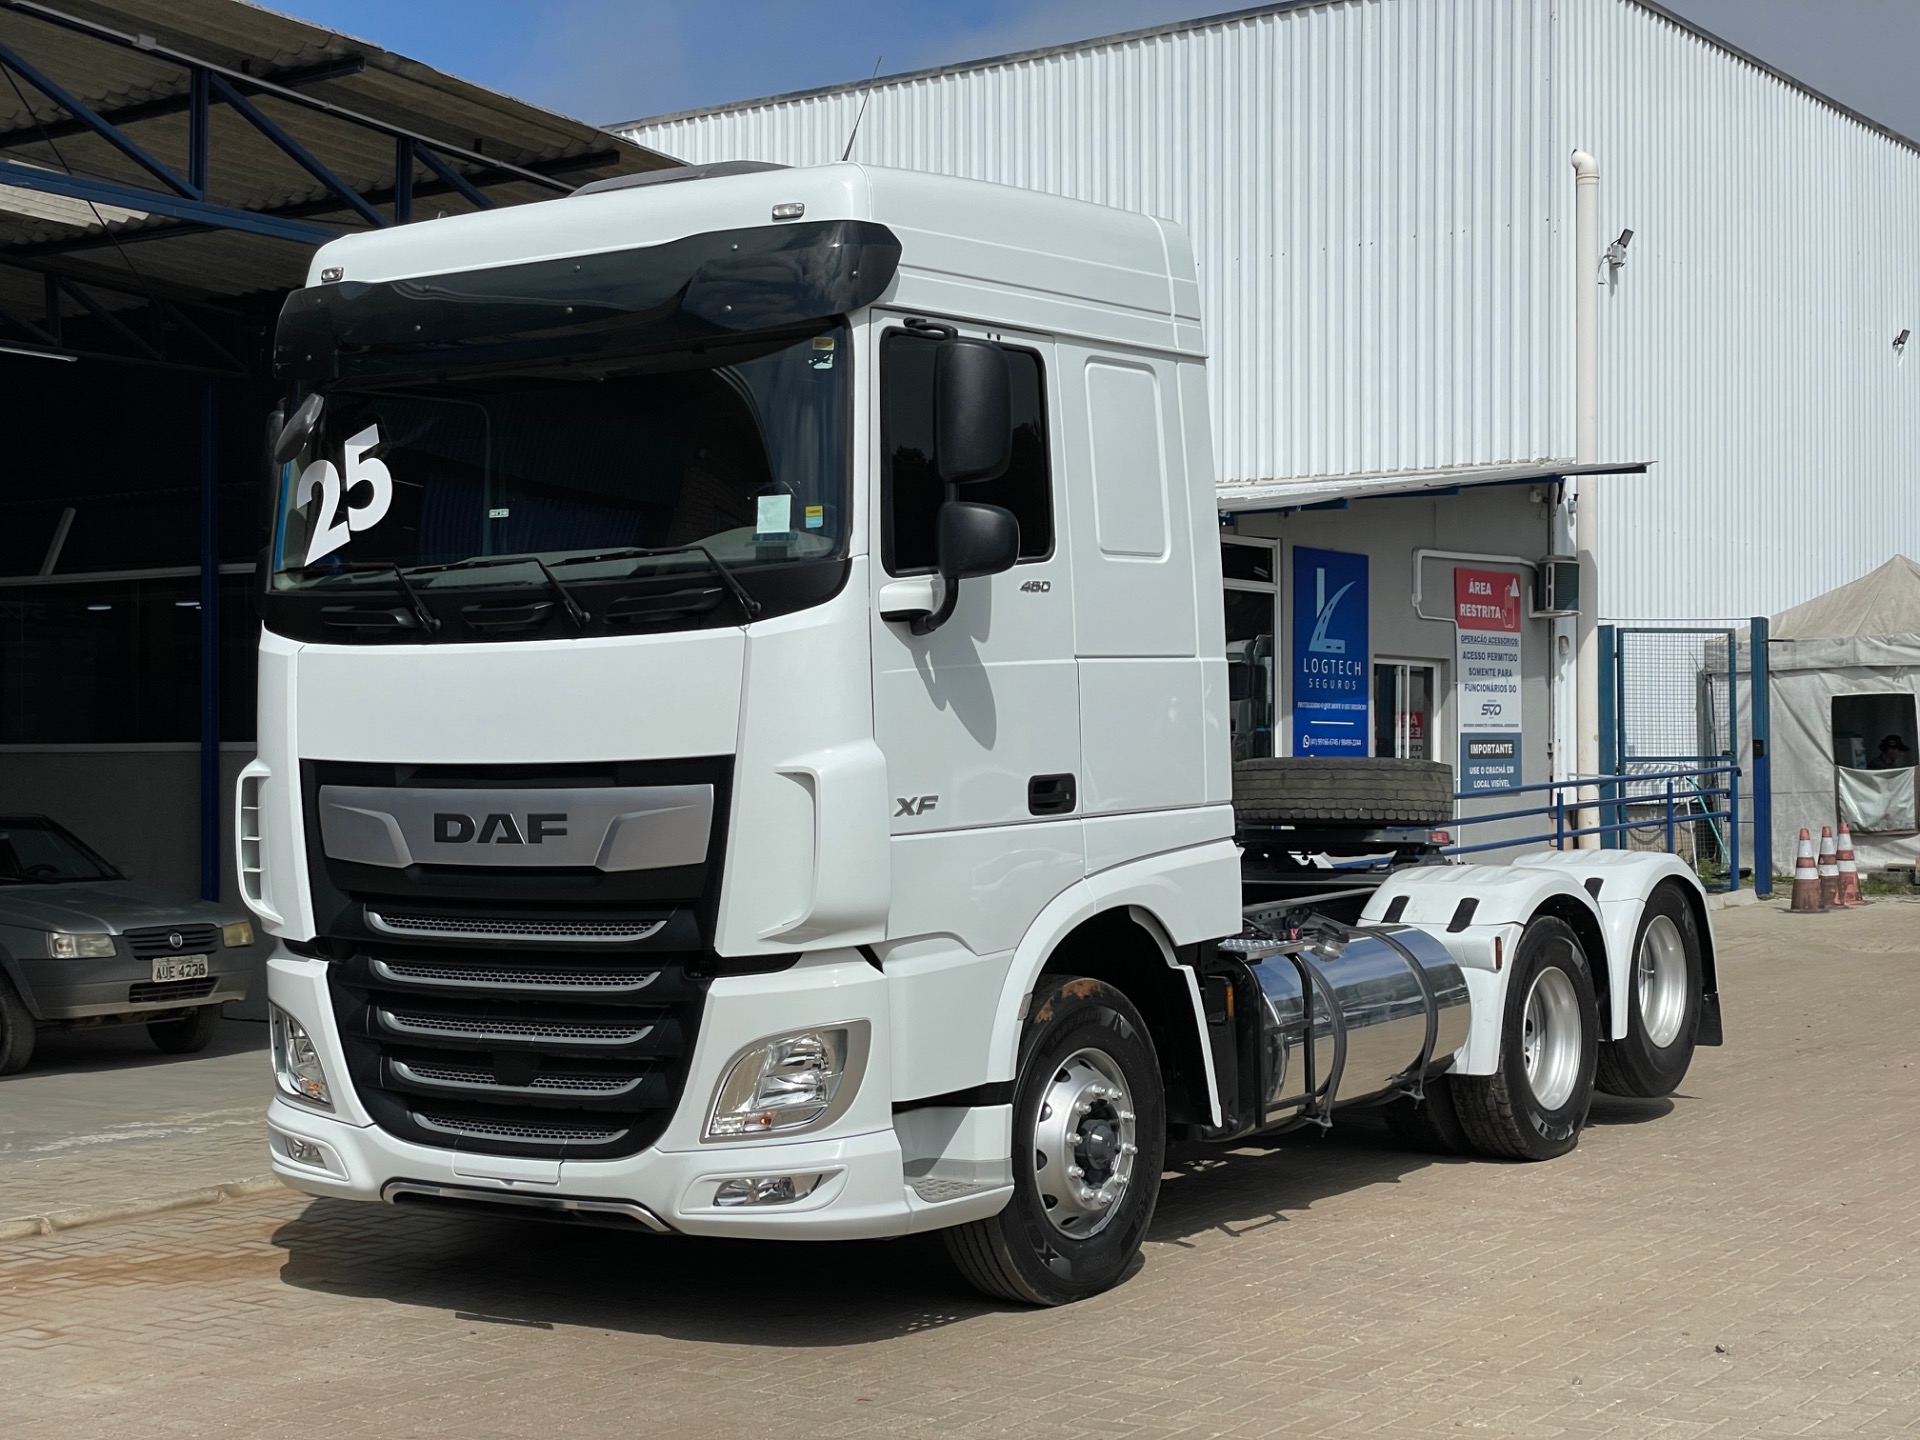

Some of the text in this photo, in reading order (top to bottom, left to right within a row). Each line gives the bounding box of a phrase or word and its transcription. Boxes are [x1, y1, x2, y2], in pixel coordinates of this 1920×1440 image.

[297, 423, 393, 567] 25
[1469, 578, 1492, 595] ÁREA
[1460, 604, 1501, 619] RESTRITA
[1463, 651, 1518, 662] ACESSO PERMITIDO
[1303, 658, 1362, 676] LOGTECH
[1469, 668, 1512, 677] SOMENTE PARA
[1309, 678, 1356, 690] SEGUROS
[1465, 682, 1517, 693] FUNCIONÁRIOS DO
[1481, 704, 1502, 716] SVD
[1470, 744, 1513, 754] IMPORTANTE
[1469, 766, 1480, 775] USE
[1486, 764, 1505, 774] CRACHÁ
[1474, 778, 1510, 788] LOCAL VISÍVEL
[894, 795, 939, 817] XF
[434, 813, 567, 845] DAF
[156, 966, 175, 980] AUE
